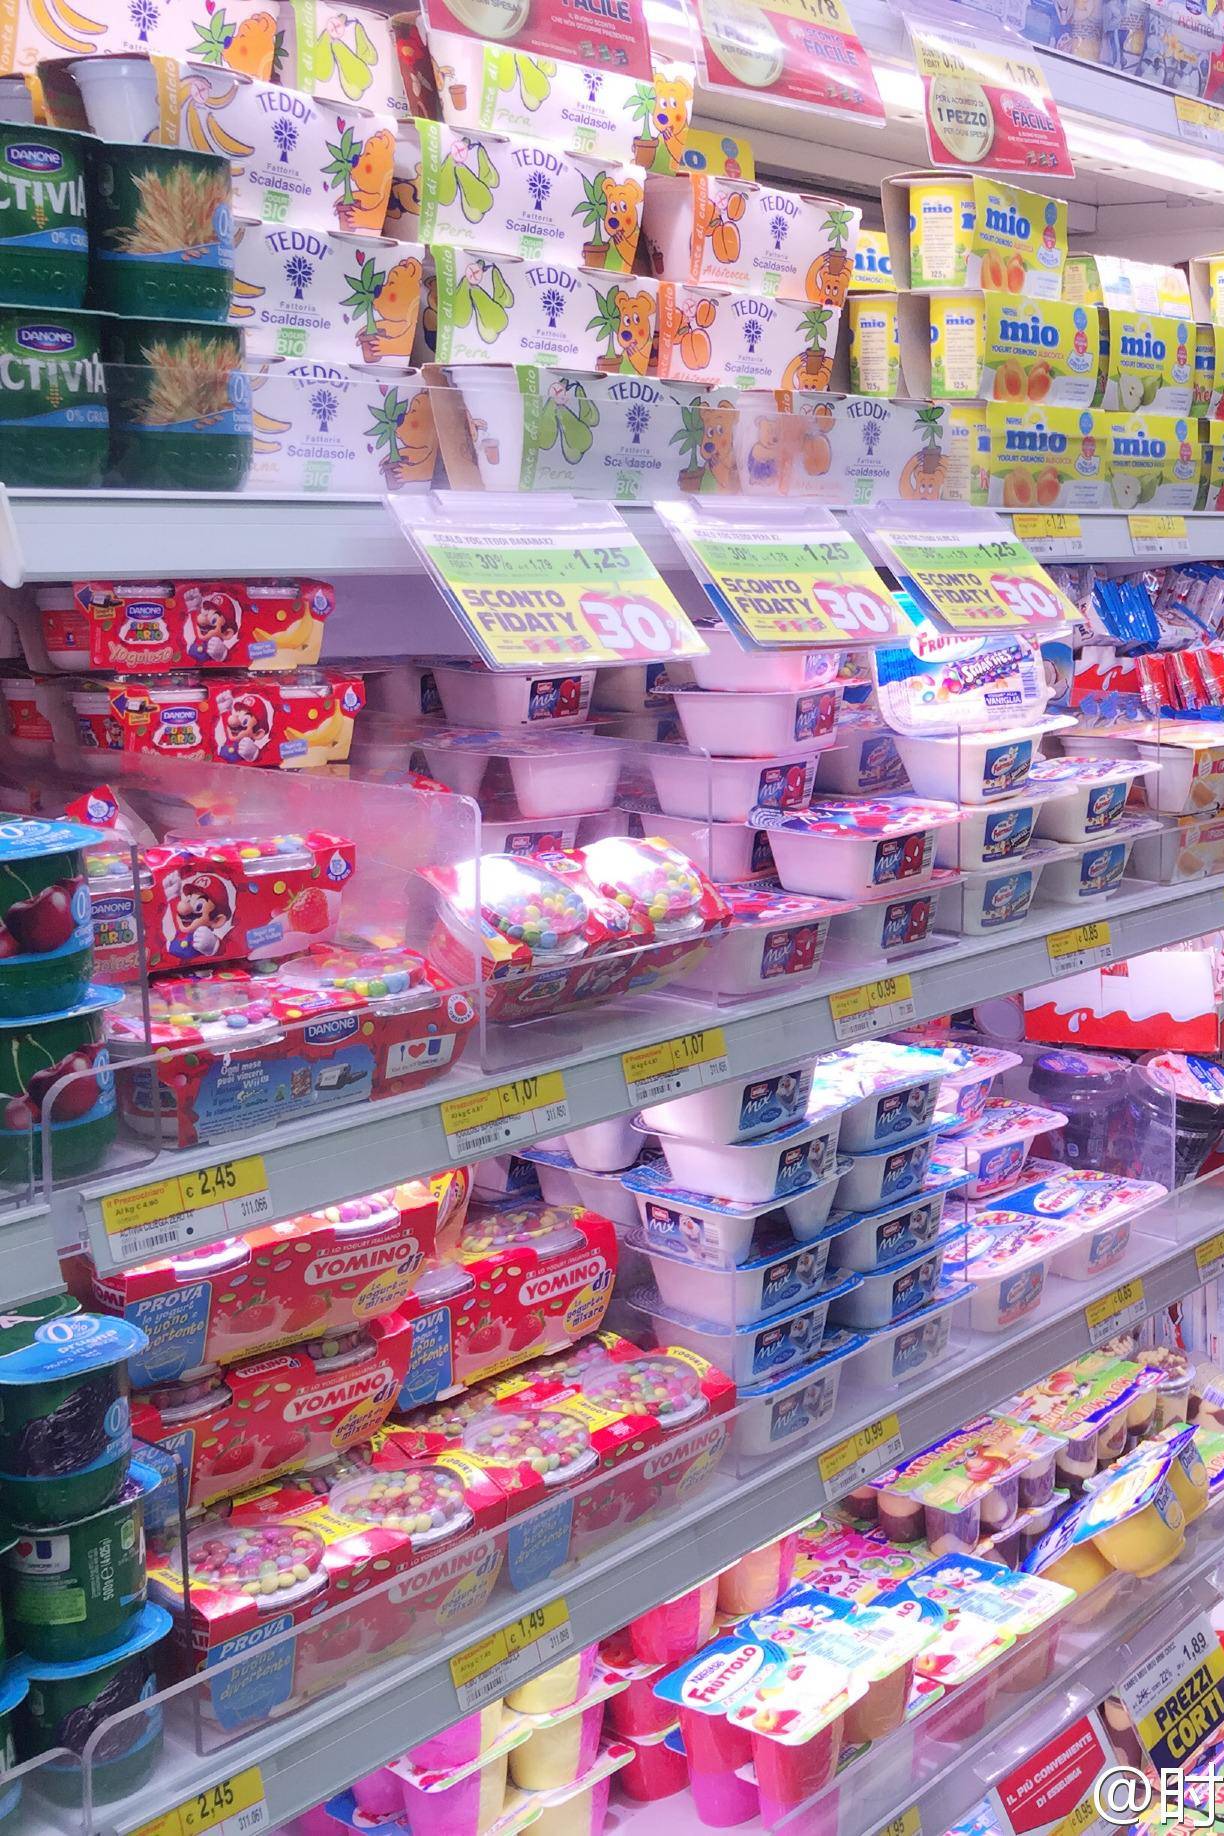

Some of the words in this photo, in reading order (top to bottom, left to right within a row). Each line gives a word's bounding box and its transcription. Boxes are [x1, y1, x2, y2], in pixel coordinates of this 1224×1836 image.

[804, 38, 858, 66] FACILE
[166, 58, 178, 115] calcio
[256, 90, 313, 124] TEDDI
[947, 109, 988, 127] PEZZO
[561, 108, 617, 132] Scaldasole
[1012, 110, 1056, 131] FACILE
[10, 148, 61, 164] DANONE
[511, 147, 567, 177] TEDDI
[249, 173, 313, 197] Scaldasole
[760, 195, 800, 218] TEDDI
[923, 203, 953, 215] mio
[505, 218, 566, 240] Scaldasole
[986, 204, 1031, 240] mio
[266, 230, 328, 261] TEDDI
[752, 256, 798, 275] Scaldasole
[525, 266, 577, 293] TEDDI
[260, 310, 332, 330] Scaldasole
[731, 299, 773, 322] TEDDI
[945, 315, 975, 328] mio
[21, 330, 72, 344] DANONE
[1000, 316, 1059, 348] mio
[520, 336, 579, 355] Scaldasole
[1121, 332, 1166, 360] mio
[288, 364, 351, 393] TEDDI
[724, 360, 772, 377] Scaldasole
[608, 380, 661, 405] TEDDI
[847, 400, 888, 422] TEDDI
[1006, 424, 1068, 454] mio
[1113, 431, 1167, 457] mio
[287, 445, 356, 462] Scaldasole
[573, 547, 631, 573] 1,25
[803, 542, 850, 563] 1,25
[979, 541, 1017, 559] 1,25
[722, 577, 802, 595] SCONTO
[917, 572, 983, 588] SCONTO
[461, 589, 567, 609] SCONTO
[736, 597, 815, 616] FIDATY
[934, 588, 994, 605] FIDATY
[129, 606, 162, 616] DANONE
[478, 611, 579, 633] FIDATY
[986, 695, 1021, 706] VANIGLIA
[164, 710, 196, 722] DANONE
[92, 901, 131, 914] DANONE
[877, 979, 897, 998] 0,99
[308, 1015, 357, 1037] DANONE
[682, 1033, 704, 1057] 1,07
[511, 1077, 539, 1106] 1,07
[186, 1186, 194, 1198] €
[198, 1163, 237, 1197] 2,45
[342, 1239, 370, 1251] YOGURT
[370, 1232, 401, 1245] ITALIANO
[313, 1244, 412, 1281] YOMINO
[526, 1261, 600, 1301] YOMINO
[136, 1285, 203, 1318] PROVA
[155, 1302, 194, 1320] yogurt
[288, 1374, 387, 1418] YOMINO
[649, 1428, 720, 1474] YOMINO
[400, 1545, 488, 1596] YOMINO
[518, 1608, 546, 1638] 1,49
[219, 1618, 286, 1659] PROVA
[1182, 1632, 1208, 1662] 1,89
[1153, 1664, 1214, 1732] PREZZI
[1006, 1794, 1017, 1806] IL
[1016, 1779, 1034, 1799] PIÙ
[1033, 1732, 1093, 1784] CONVENIENTE
[1035, 1796, 1047, 1809] DI
[1045, 1767, 1083, 1801] ESSELUNGA
[185, 1812, 194, 1824] €
[198, 1781, 235, 1820] 2,45
[1075, 1801, 1094, 1824] 0,95
